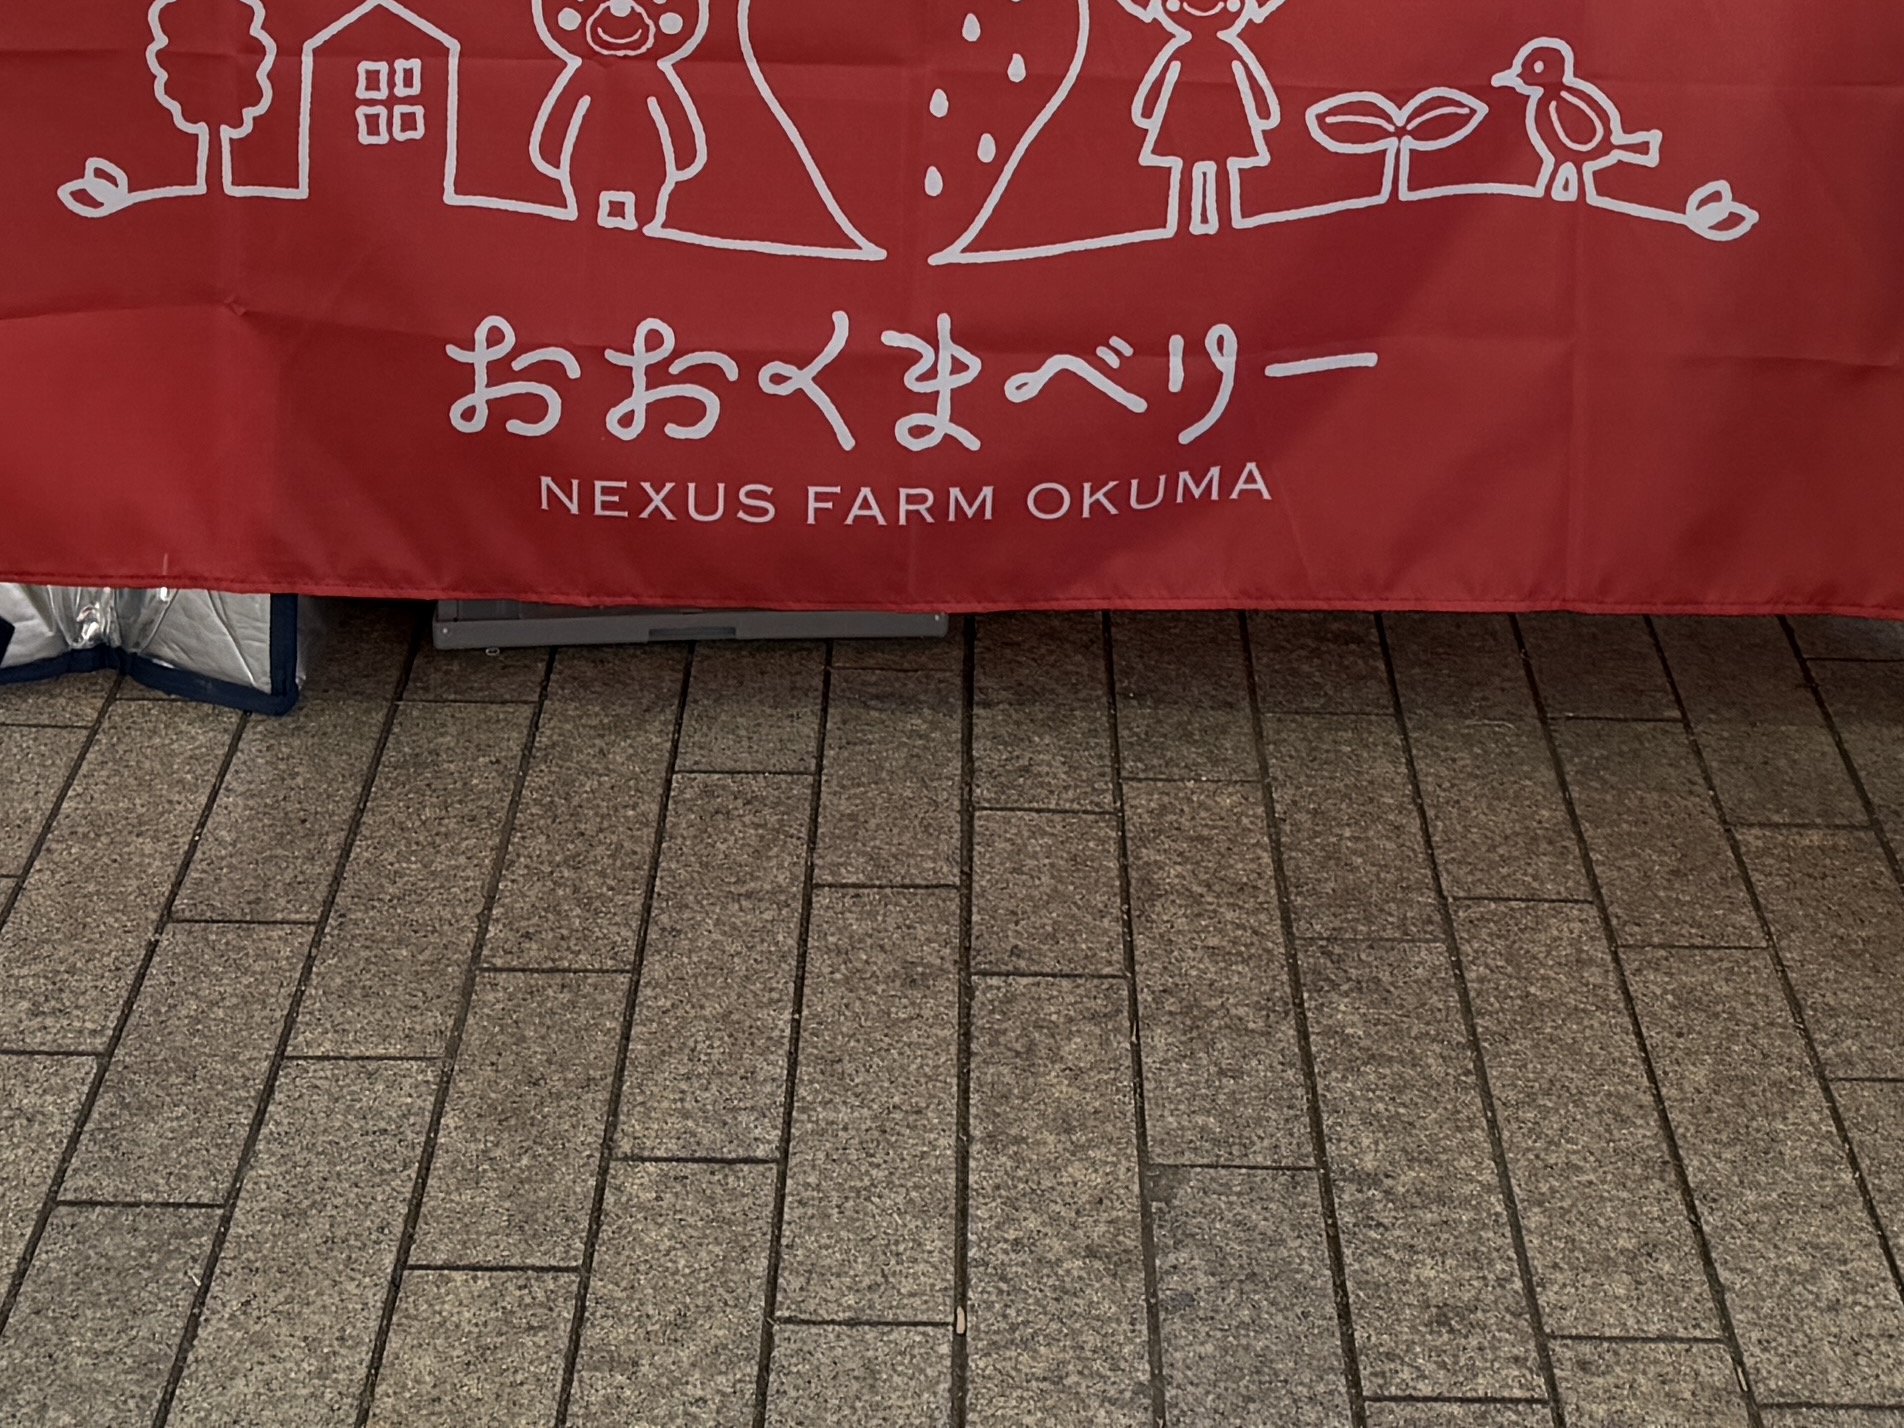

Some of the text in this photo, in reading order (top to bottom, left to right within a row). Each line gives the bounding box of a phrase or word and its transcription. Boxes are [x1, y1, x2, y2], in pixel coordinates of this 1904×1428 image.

[444, 308, 1379, 452] おおくまベリー
[538, 461, 1274, 526] NEXUS FARM OKUMA
